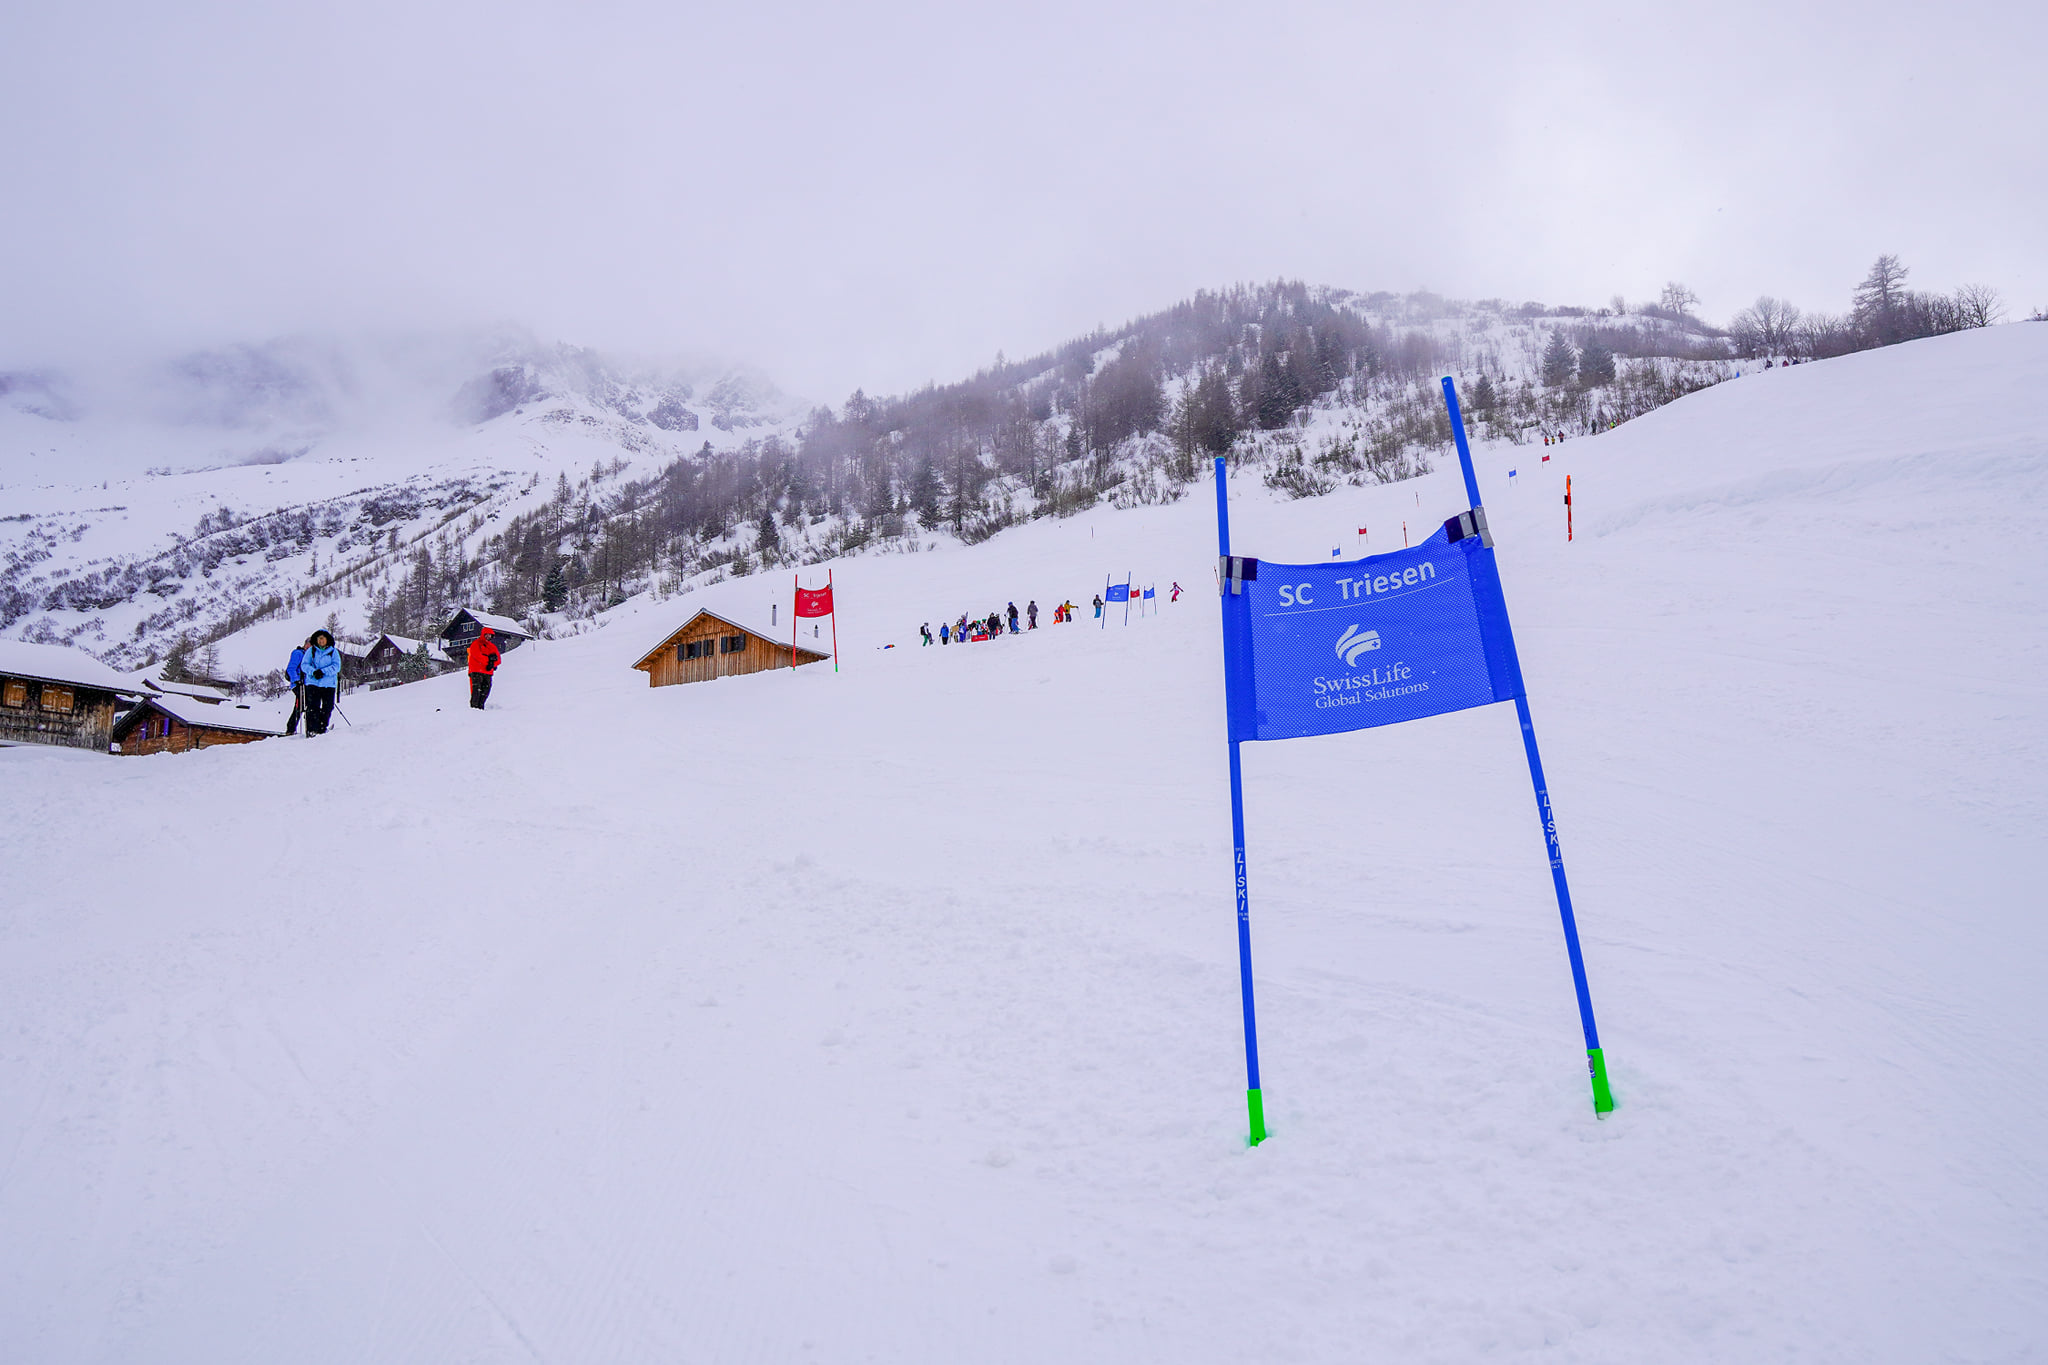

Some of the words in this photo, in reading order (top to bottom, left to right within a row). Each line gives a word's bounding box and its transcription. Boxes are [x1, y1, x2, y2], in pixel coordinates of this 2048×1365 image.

[1278, 582, 1314, 607] SC
[1335, 561, 1436, 600] Triesen
[1313, 661, 1413, 695] SwissLife
[1315, 691, 1361, 709] Global
[1365, 681, 1430, 702] Solutions
[1543, 795, 1560, 858] LISKI
[1236, 852, 1246, 911] LISKI
